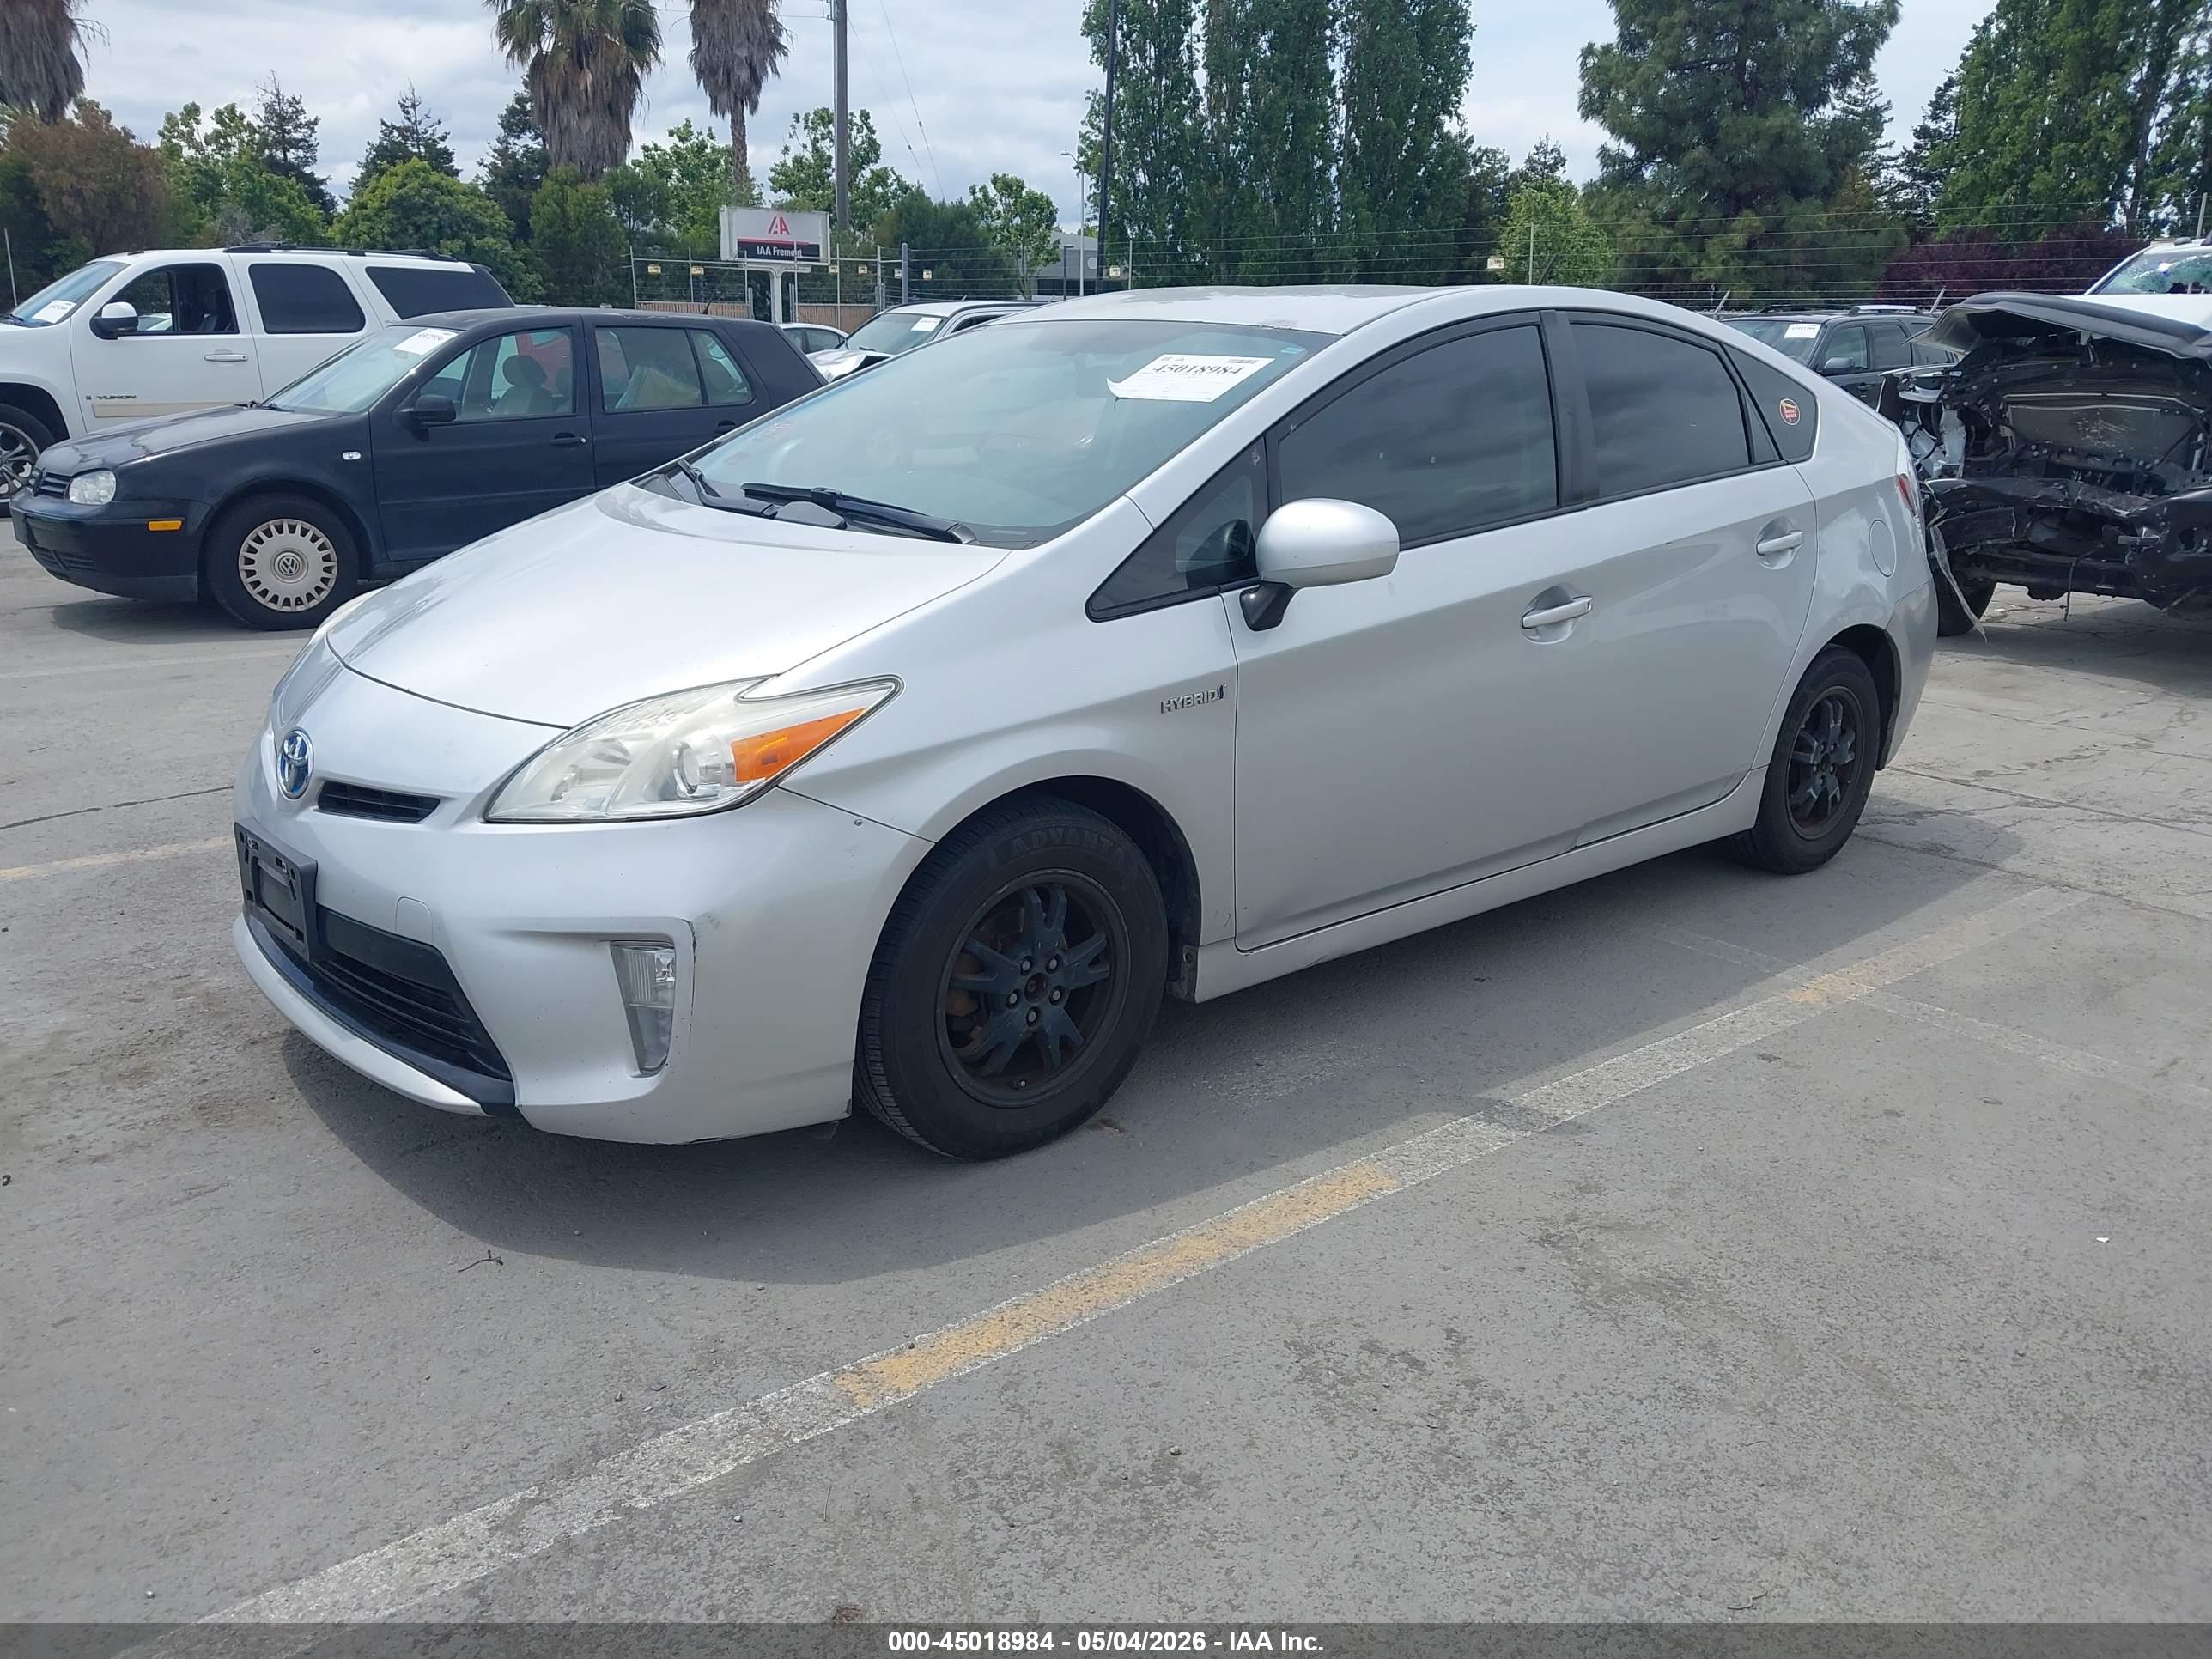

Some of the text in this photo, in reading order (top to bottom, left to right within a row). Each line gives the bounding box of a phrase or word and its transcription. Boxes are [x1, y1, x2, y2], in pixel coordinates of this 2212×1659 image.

[757, 246, 772, 256] IAA
[1152, 363, 1245, 375] 45018984
[1160, 690, 1217, 714] HYBRID
